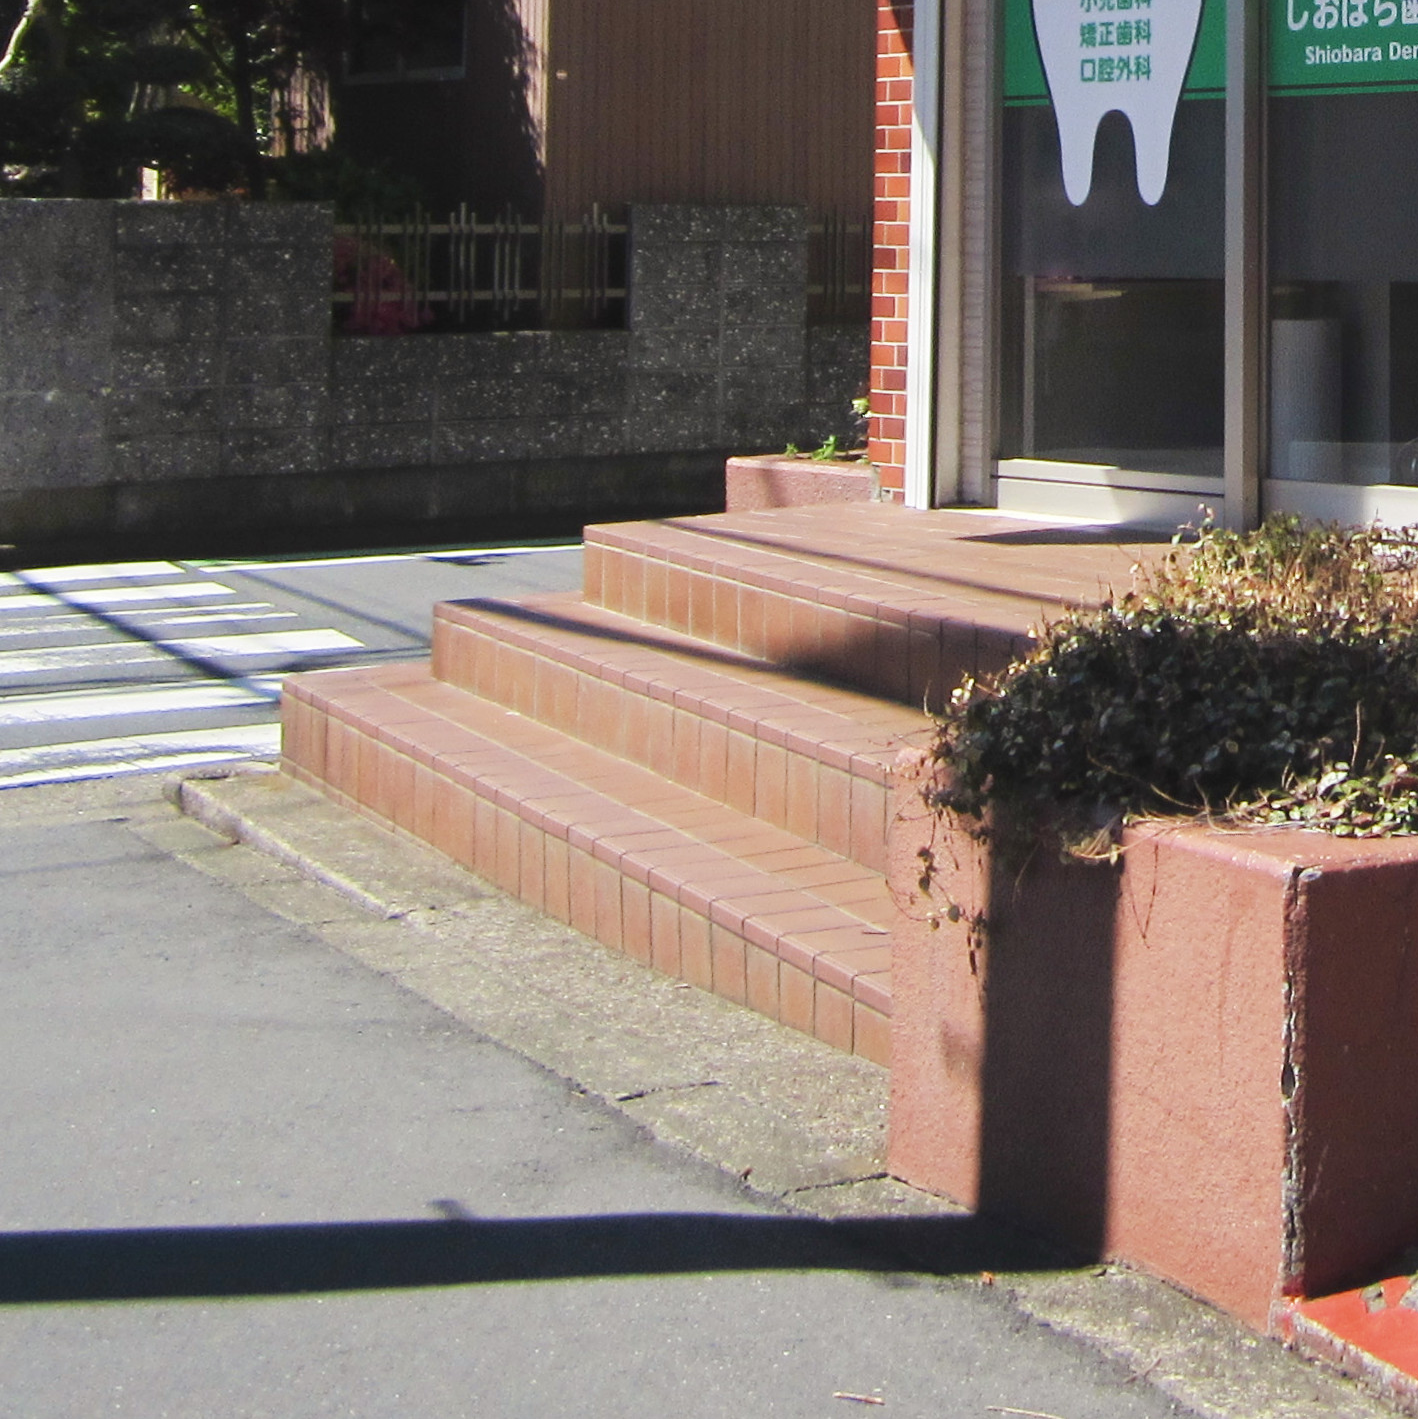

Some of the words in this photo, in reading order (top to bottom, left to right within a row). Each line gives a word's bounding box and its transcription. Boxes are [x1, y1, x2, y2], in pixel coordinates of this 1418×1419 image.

[1080, 18, 1152, 48] 矯正歯科
[1304, 41, 1383, 65] Shiobara
[1080, 54, 1152, 82] 口腔外科
